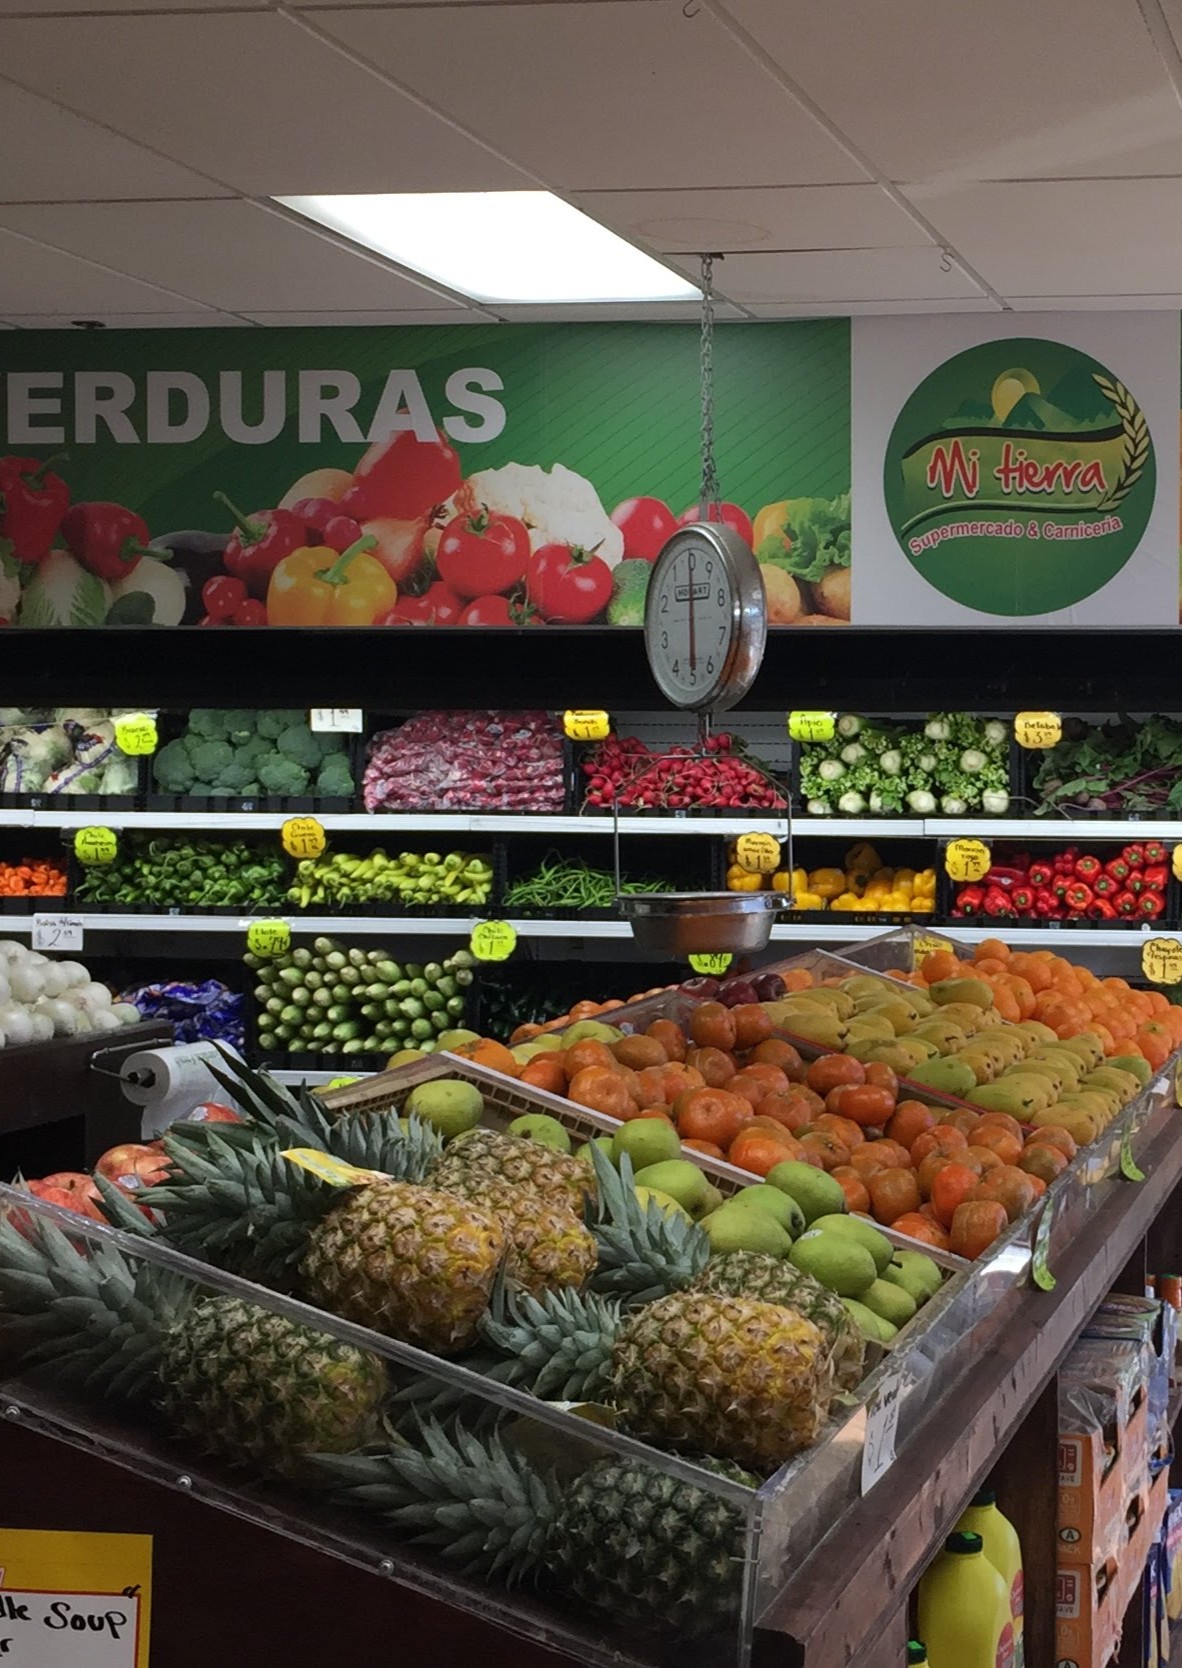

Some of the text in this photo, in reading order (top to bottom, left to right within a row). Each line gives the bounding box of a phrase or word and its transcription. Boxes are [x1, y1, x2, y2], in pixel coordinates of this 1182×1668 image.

[928, 438, 979, 497] Mi
[909, 515, 1123, 555] Supermercado & Carniceria
[705, 561, 713, 580] 9
[678, 586, 707, 597] HOART
[717, 588, 725, 607] 8
[661, 594, 669, 613] 2
[661, 631, 669, 649] 3
[719, 626, 726, 645] 7
[672, 659, 679, 677] 4
[706, 656, 714, 674] 6
